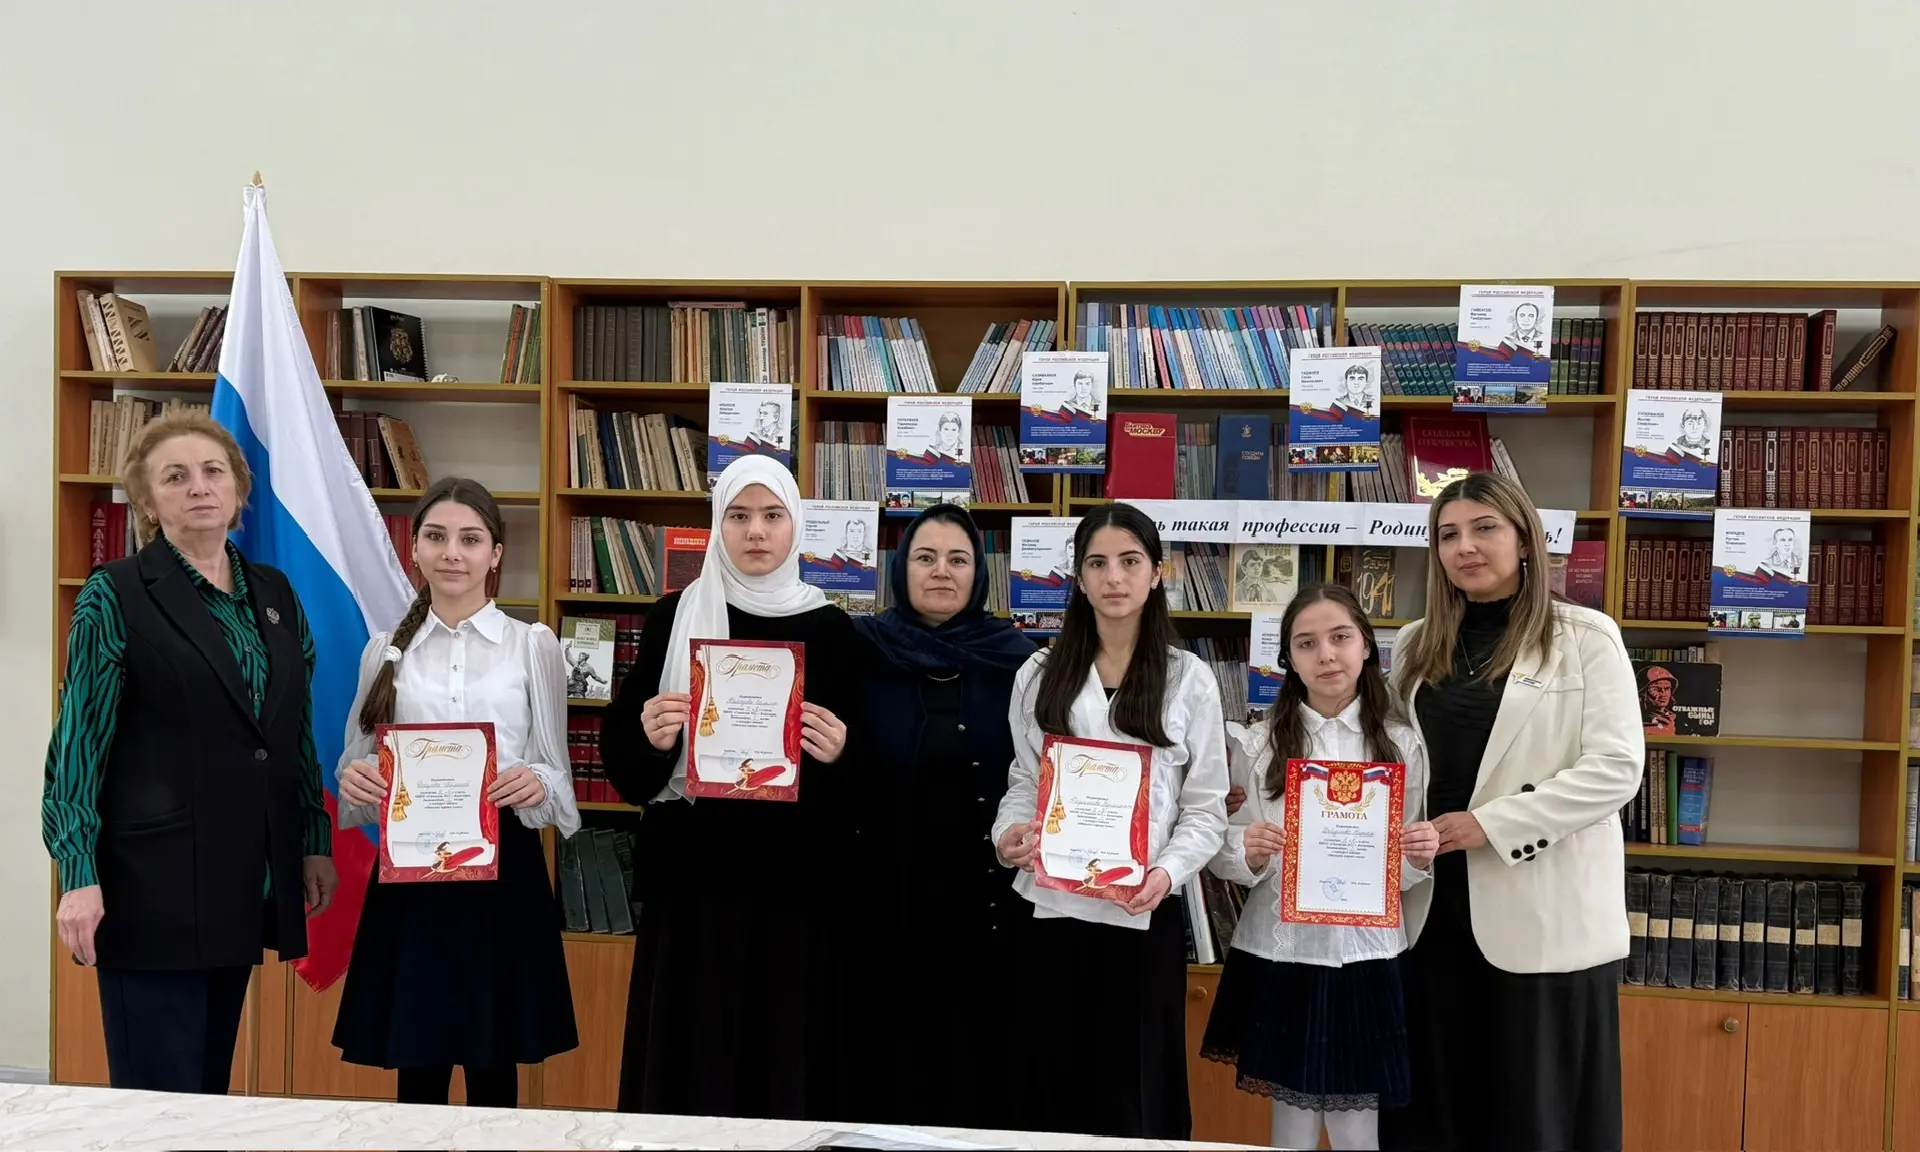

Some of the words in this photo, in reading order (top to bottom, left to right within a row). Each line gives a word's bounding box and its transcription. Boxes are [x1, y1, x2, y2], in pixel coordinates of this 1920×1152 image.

[1422, 429, 1471, 438] СОЛДАТЫ
[1418, 439, 1477, 447] ОТЕЧЕСТВА
[1172, 518, 1229, 533] такая
[1242, 518, 1340, 538] профессия
[1369, 518, 1429, 542] Родин
[1321, 810, 1368, 820] ГРАМОТА
